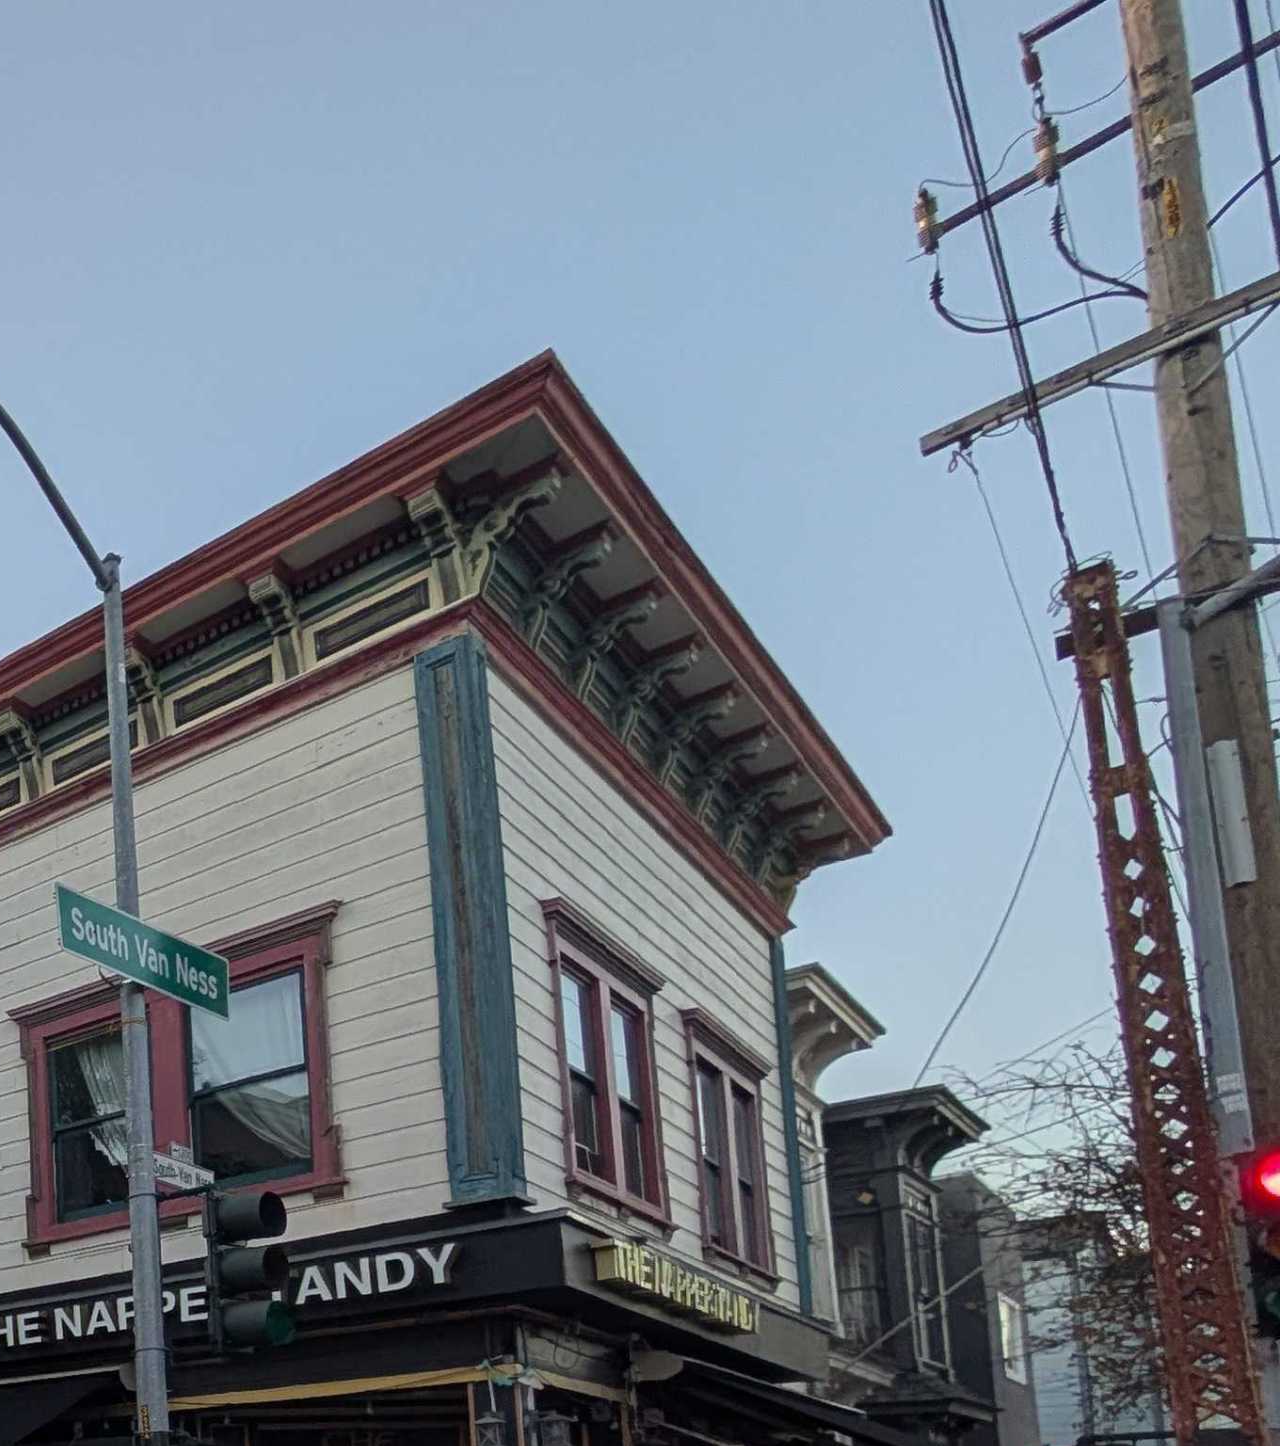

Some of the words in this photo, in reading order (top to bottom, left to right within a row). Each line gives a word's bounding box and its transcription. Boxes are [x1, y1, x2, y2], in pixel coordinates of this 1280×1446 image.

[71, 907, 129, 960] South
[134, 935, 169, 979] Van
[176, 953, 218, 999] Ness
[54, 1285, 209, 1340] NAPE
[274, 1243, 455, 1306] ANDY
